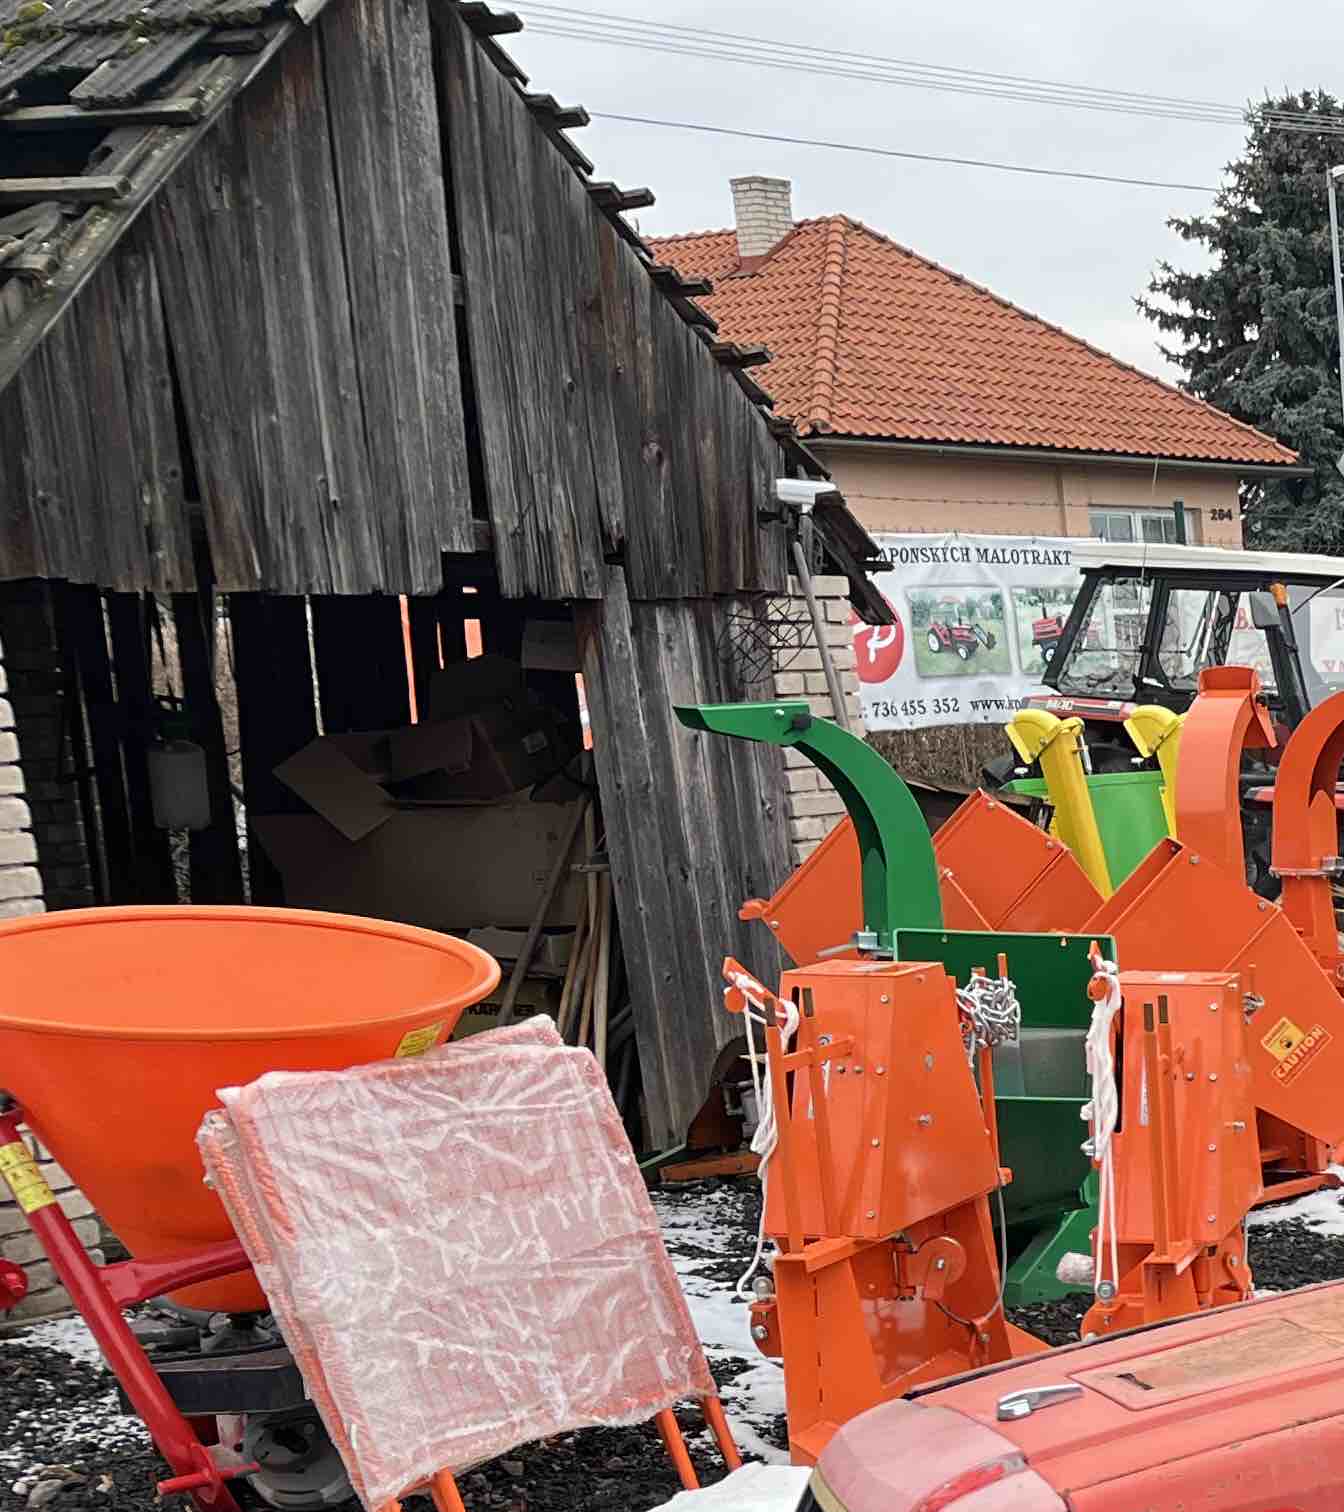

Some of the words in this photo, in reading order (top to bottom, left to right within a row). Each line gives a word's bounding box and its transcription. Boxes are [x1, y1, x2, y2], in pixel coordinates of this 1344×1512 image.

[878, 546, 971, 563] APONSKÝCH
[871, 702, 898, 718] 736
[900, 699, 927, 716] 455
[933, 697, 960, 714] 352
[1275, 1027, 1323, 1078] CAUTION
